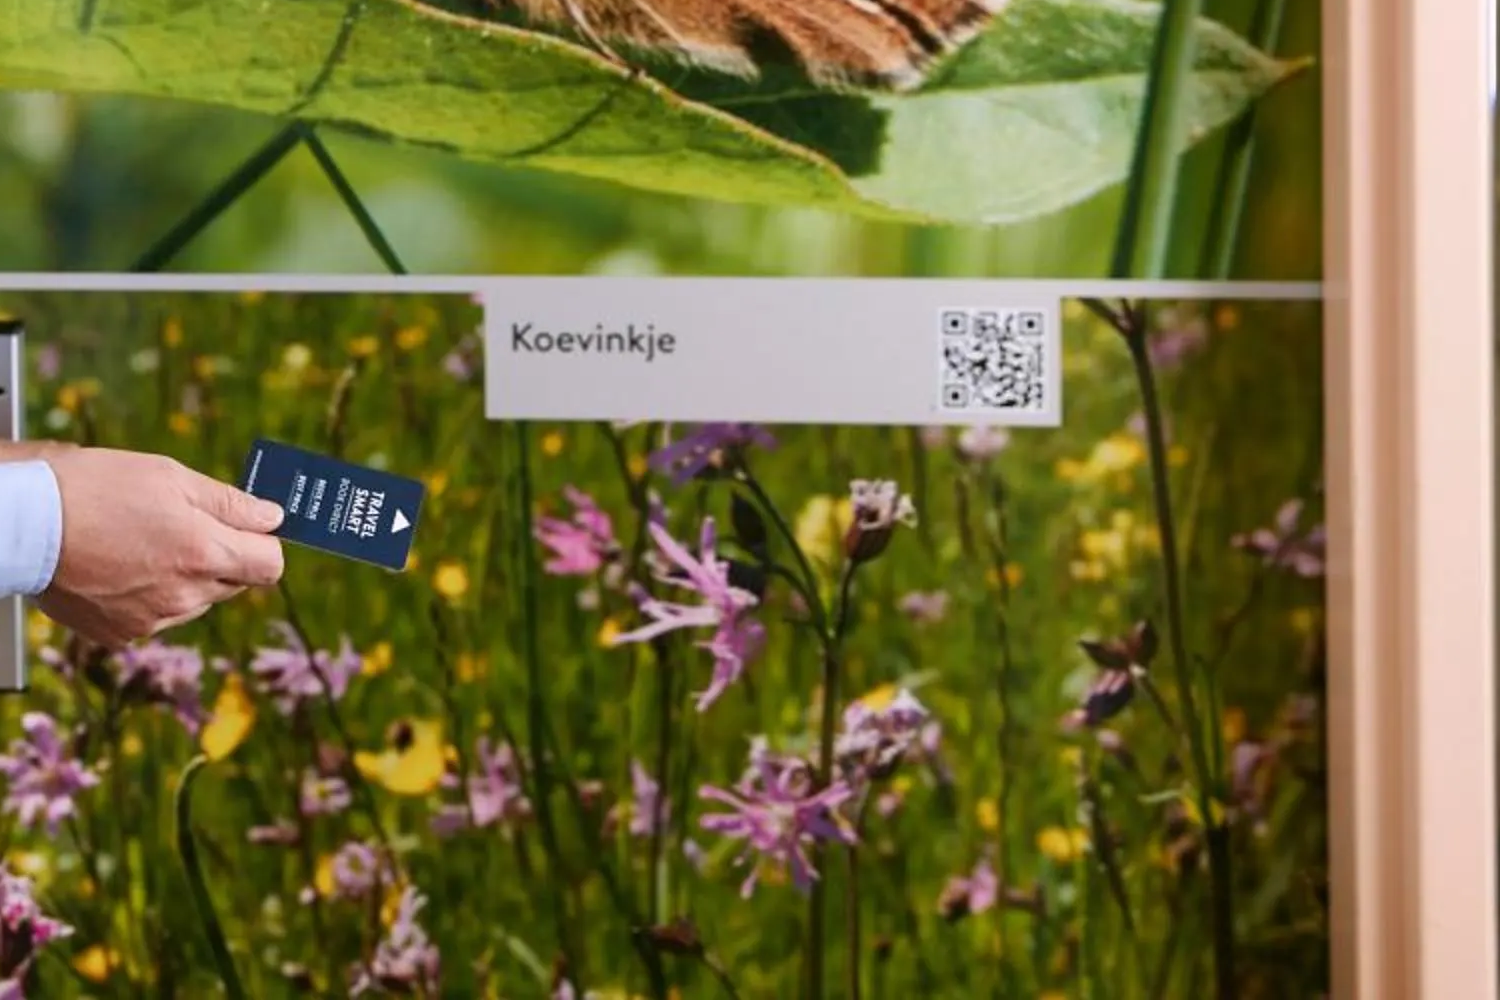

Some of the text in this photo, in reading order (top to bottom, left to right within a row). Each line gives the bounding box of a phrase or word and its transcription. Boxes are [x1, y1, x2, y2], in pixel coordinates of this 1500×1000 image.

[511, 323, 676, 361] Koevinkje
[328, 478, 351, 534] BOOK DIRECT
[346, 488, 369, 534] SMART
[360, 491, 385, 538] TRAVEL
